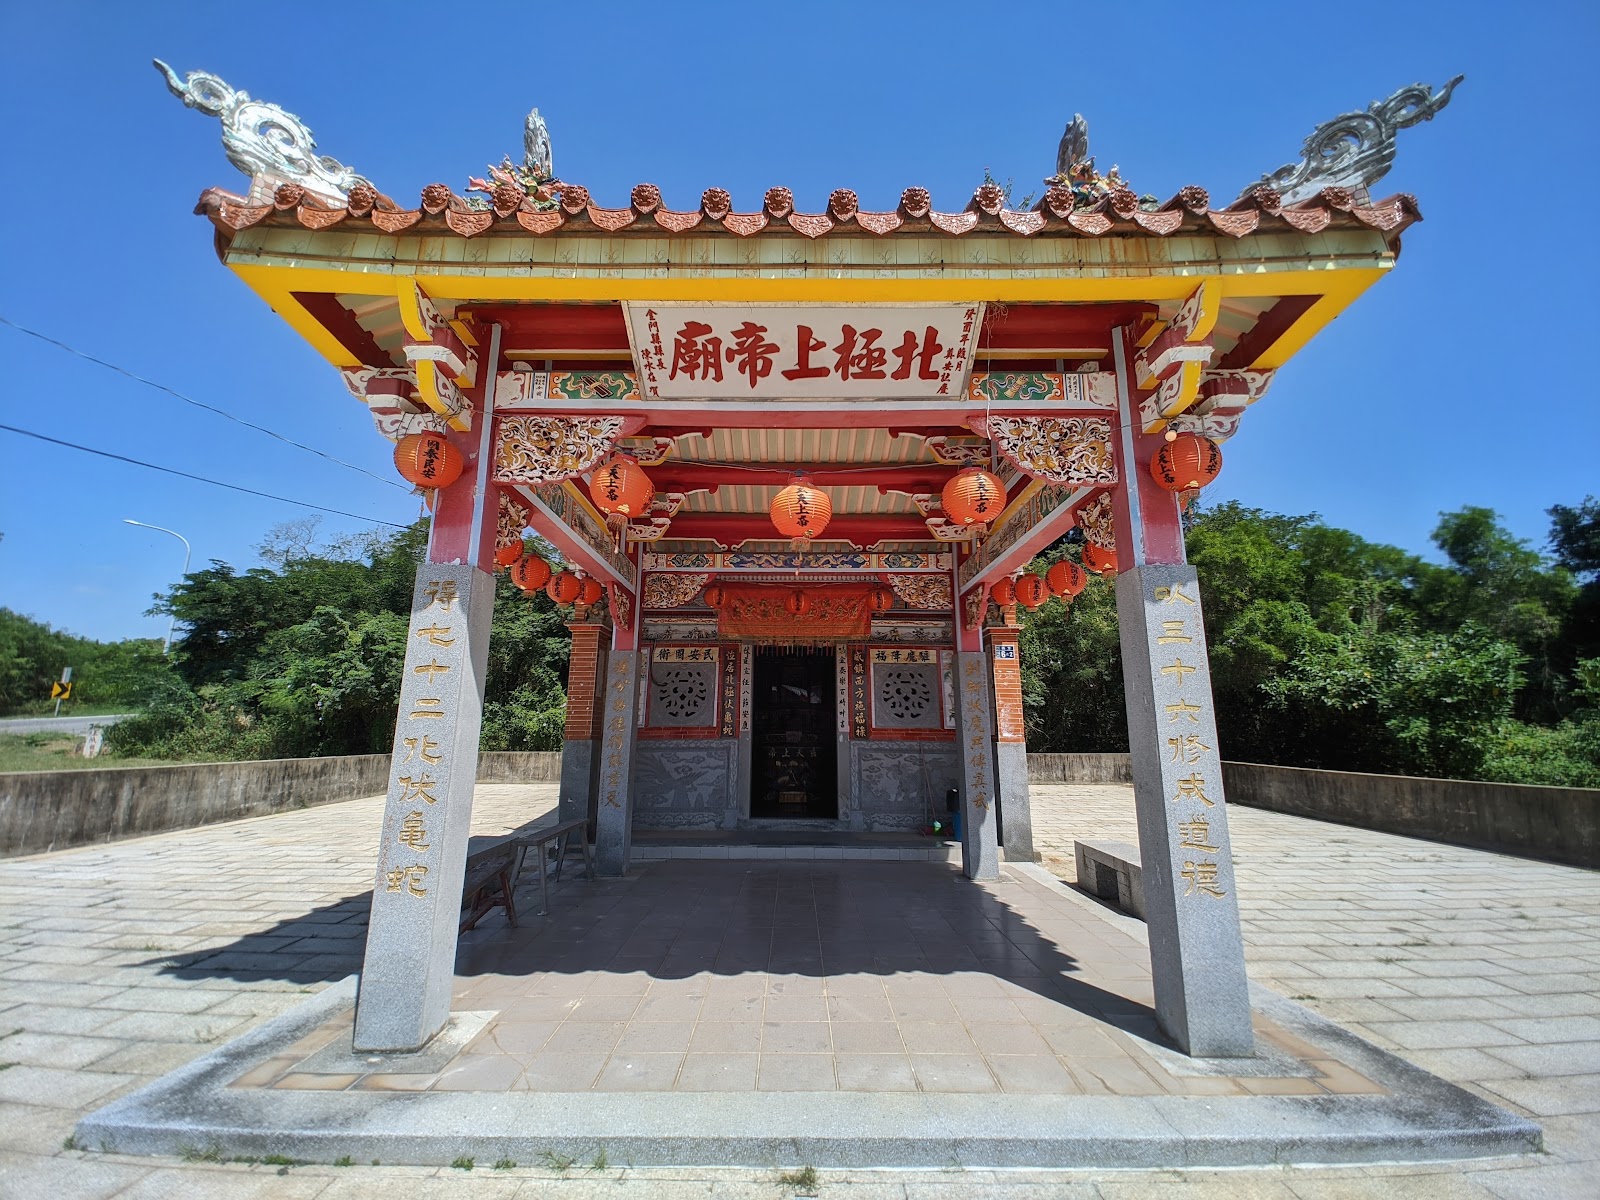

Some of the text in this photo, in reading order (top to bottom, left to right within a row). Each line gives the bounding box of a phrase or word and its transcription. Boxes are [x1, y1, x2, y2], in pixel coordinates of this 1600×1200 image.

[646, 308, 667, 370] 金門縣縣長
[669, 320, 942, 389] 北極上帝廟
[420, 440, 440, 479] 國泰民安
